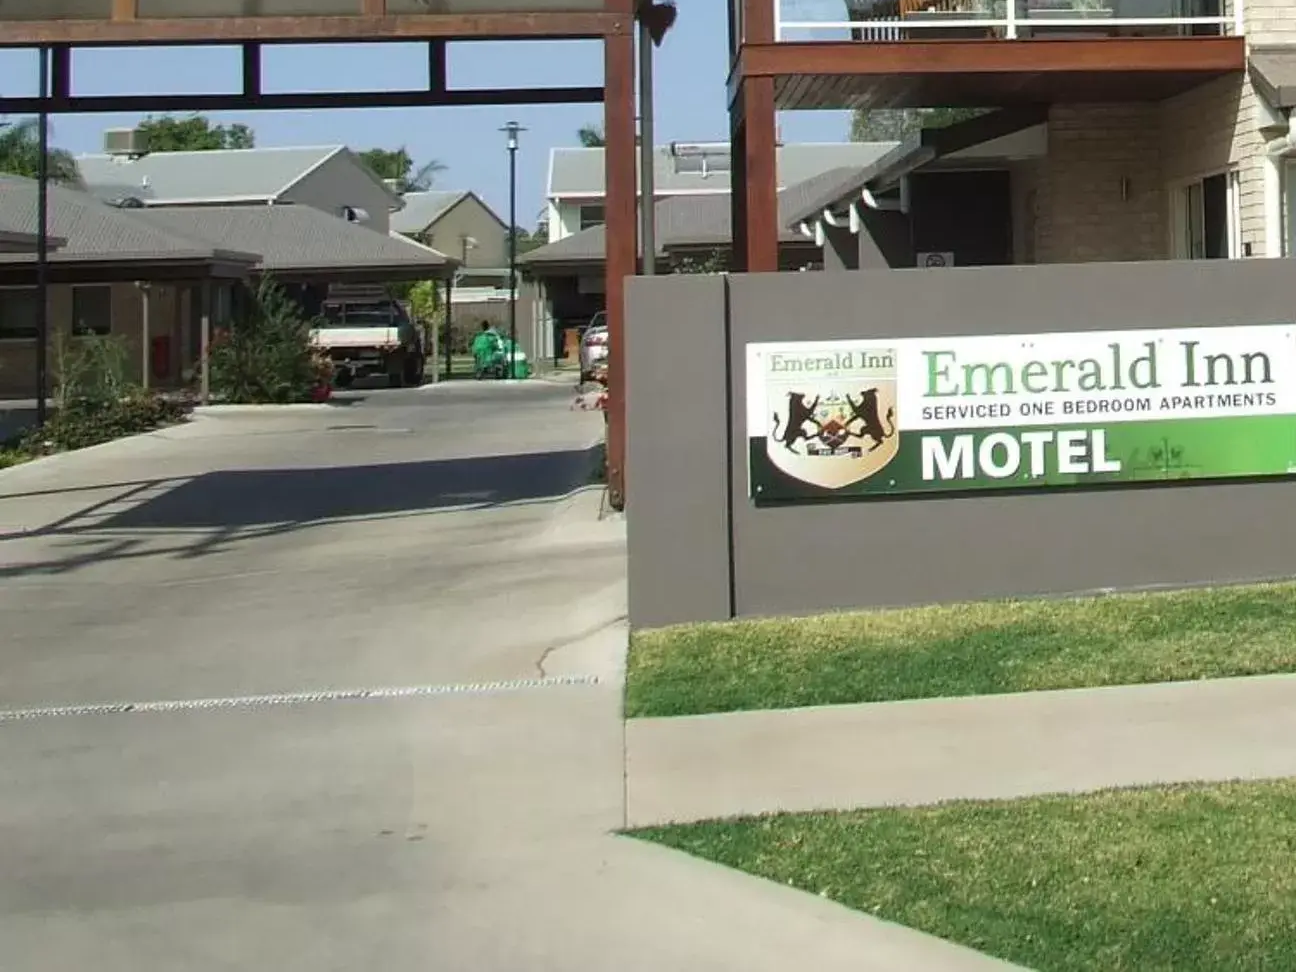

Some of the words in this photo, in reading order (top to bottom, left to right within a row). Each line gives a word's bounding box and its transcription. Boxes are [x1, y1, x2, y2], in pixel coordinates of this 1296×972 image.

[771, 352, 853, 372] Emerald
[861, 351, 894, 368] Inn
[921, 341, 1161, 398] Emerald
[1178, 339, 1275, 389] Inn
[922, 402, 1011, 421] SERVICED
[1019, 398, 1055, 416] ONE
[1062, 395, 1151, 414] BEDROOM
[1159, 391, 1276, 410] APARTMENTS
[920, 428, 1121, 481] MOTEL
